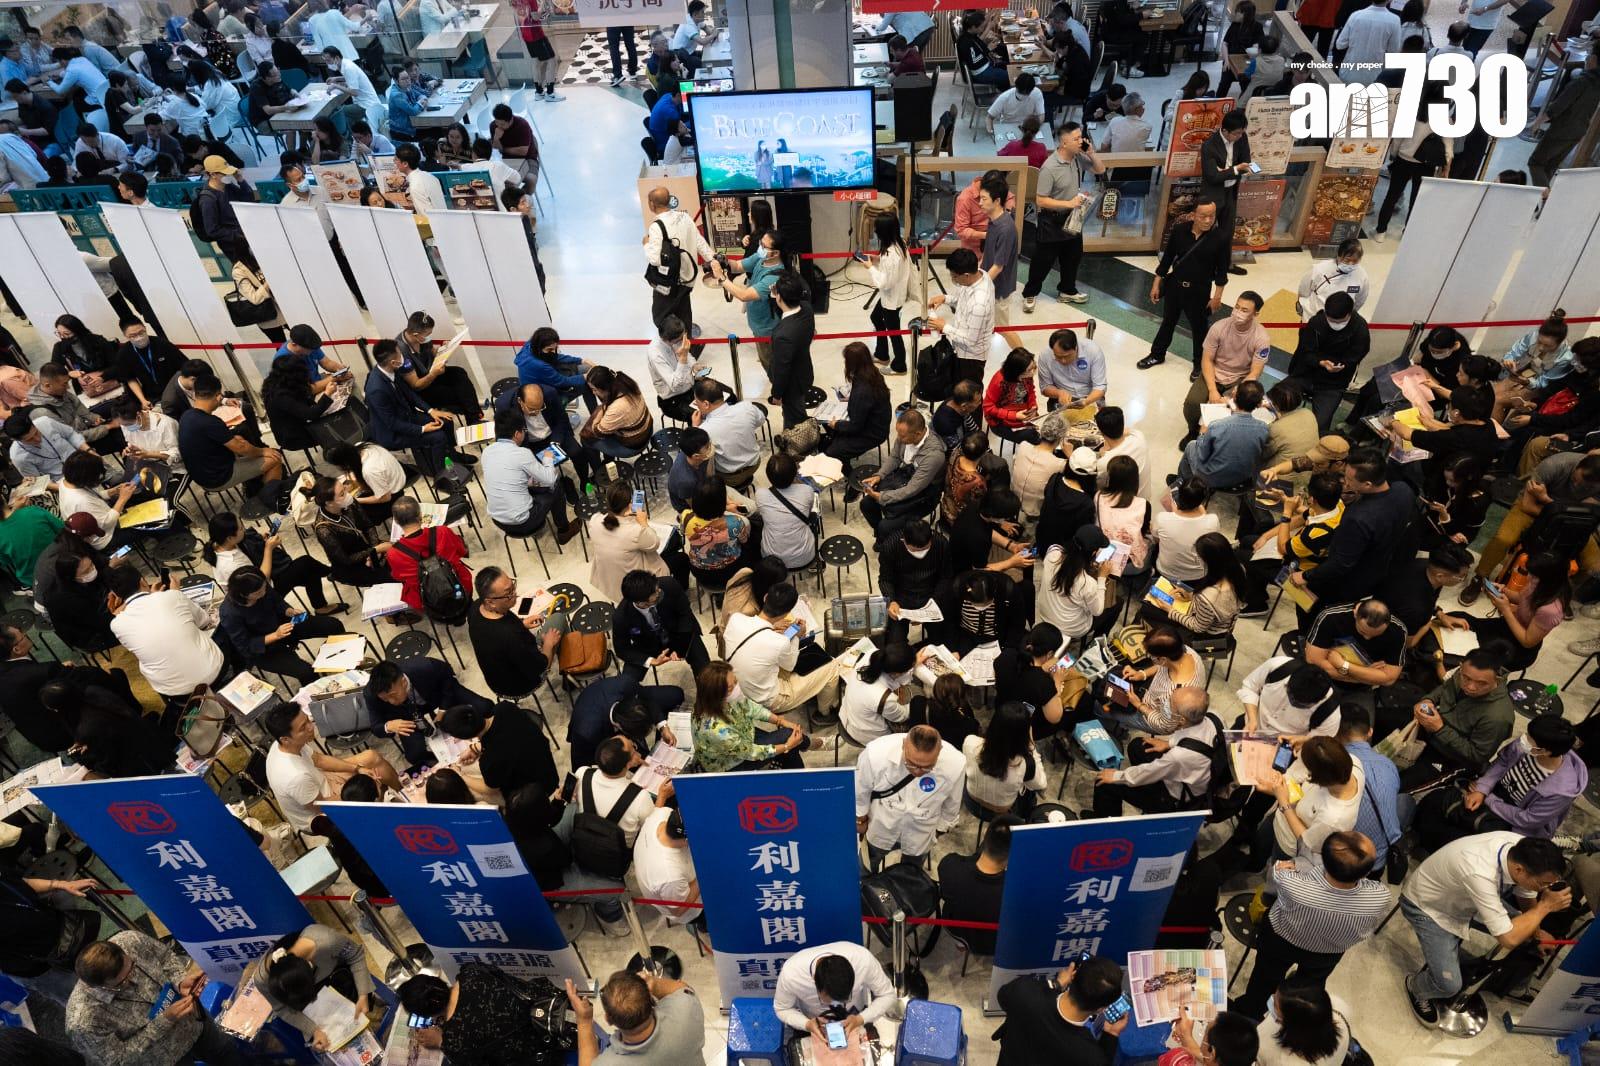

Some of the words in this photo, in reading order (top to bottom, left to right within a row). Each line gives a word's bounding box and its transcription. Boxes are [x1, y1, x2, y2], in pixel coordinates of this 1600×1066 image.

[145, 839, 258, 933] 利嘉閣
[420, 860, 510, 943] 利嘉閣
[747, 839, 807, 945] 利嘉閣
[1051, 875, 1124, 962] 利嘉閣
